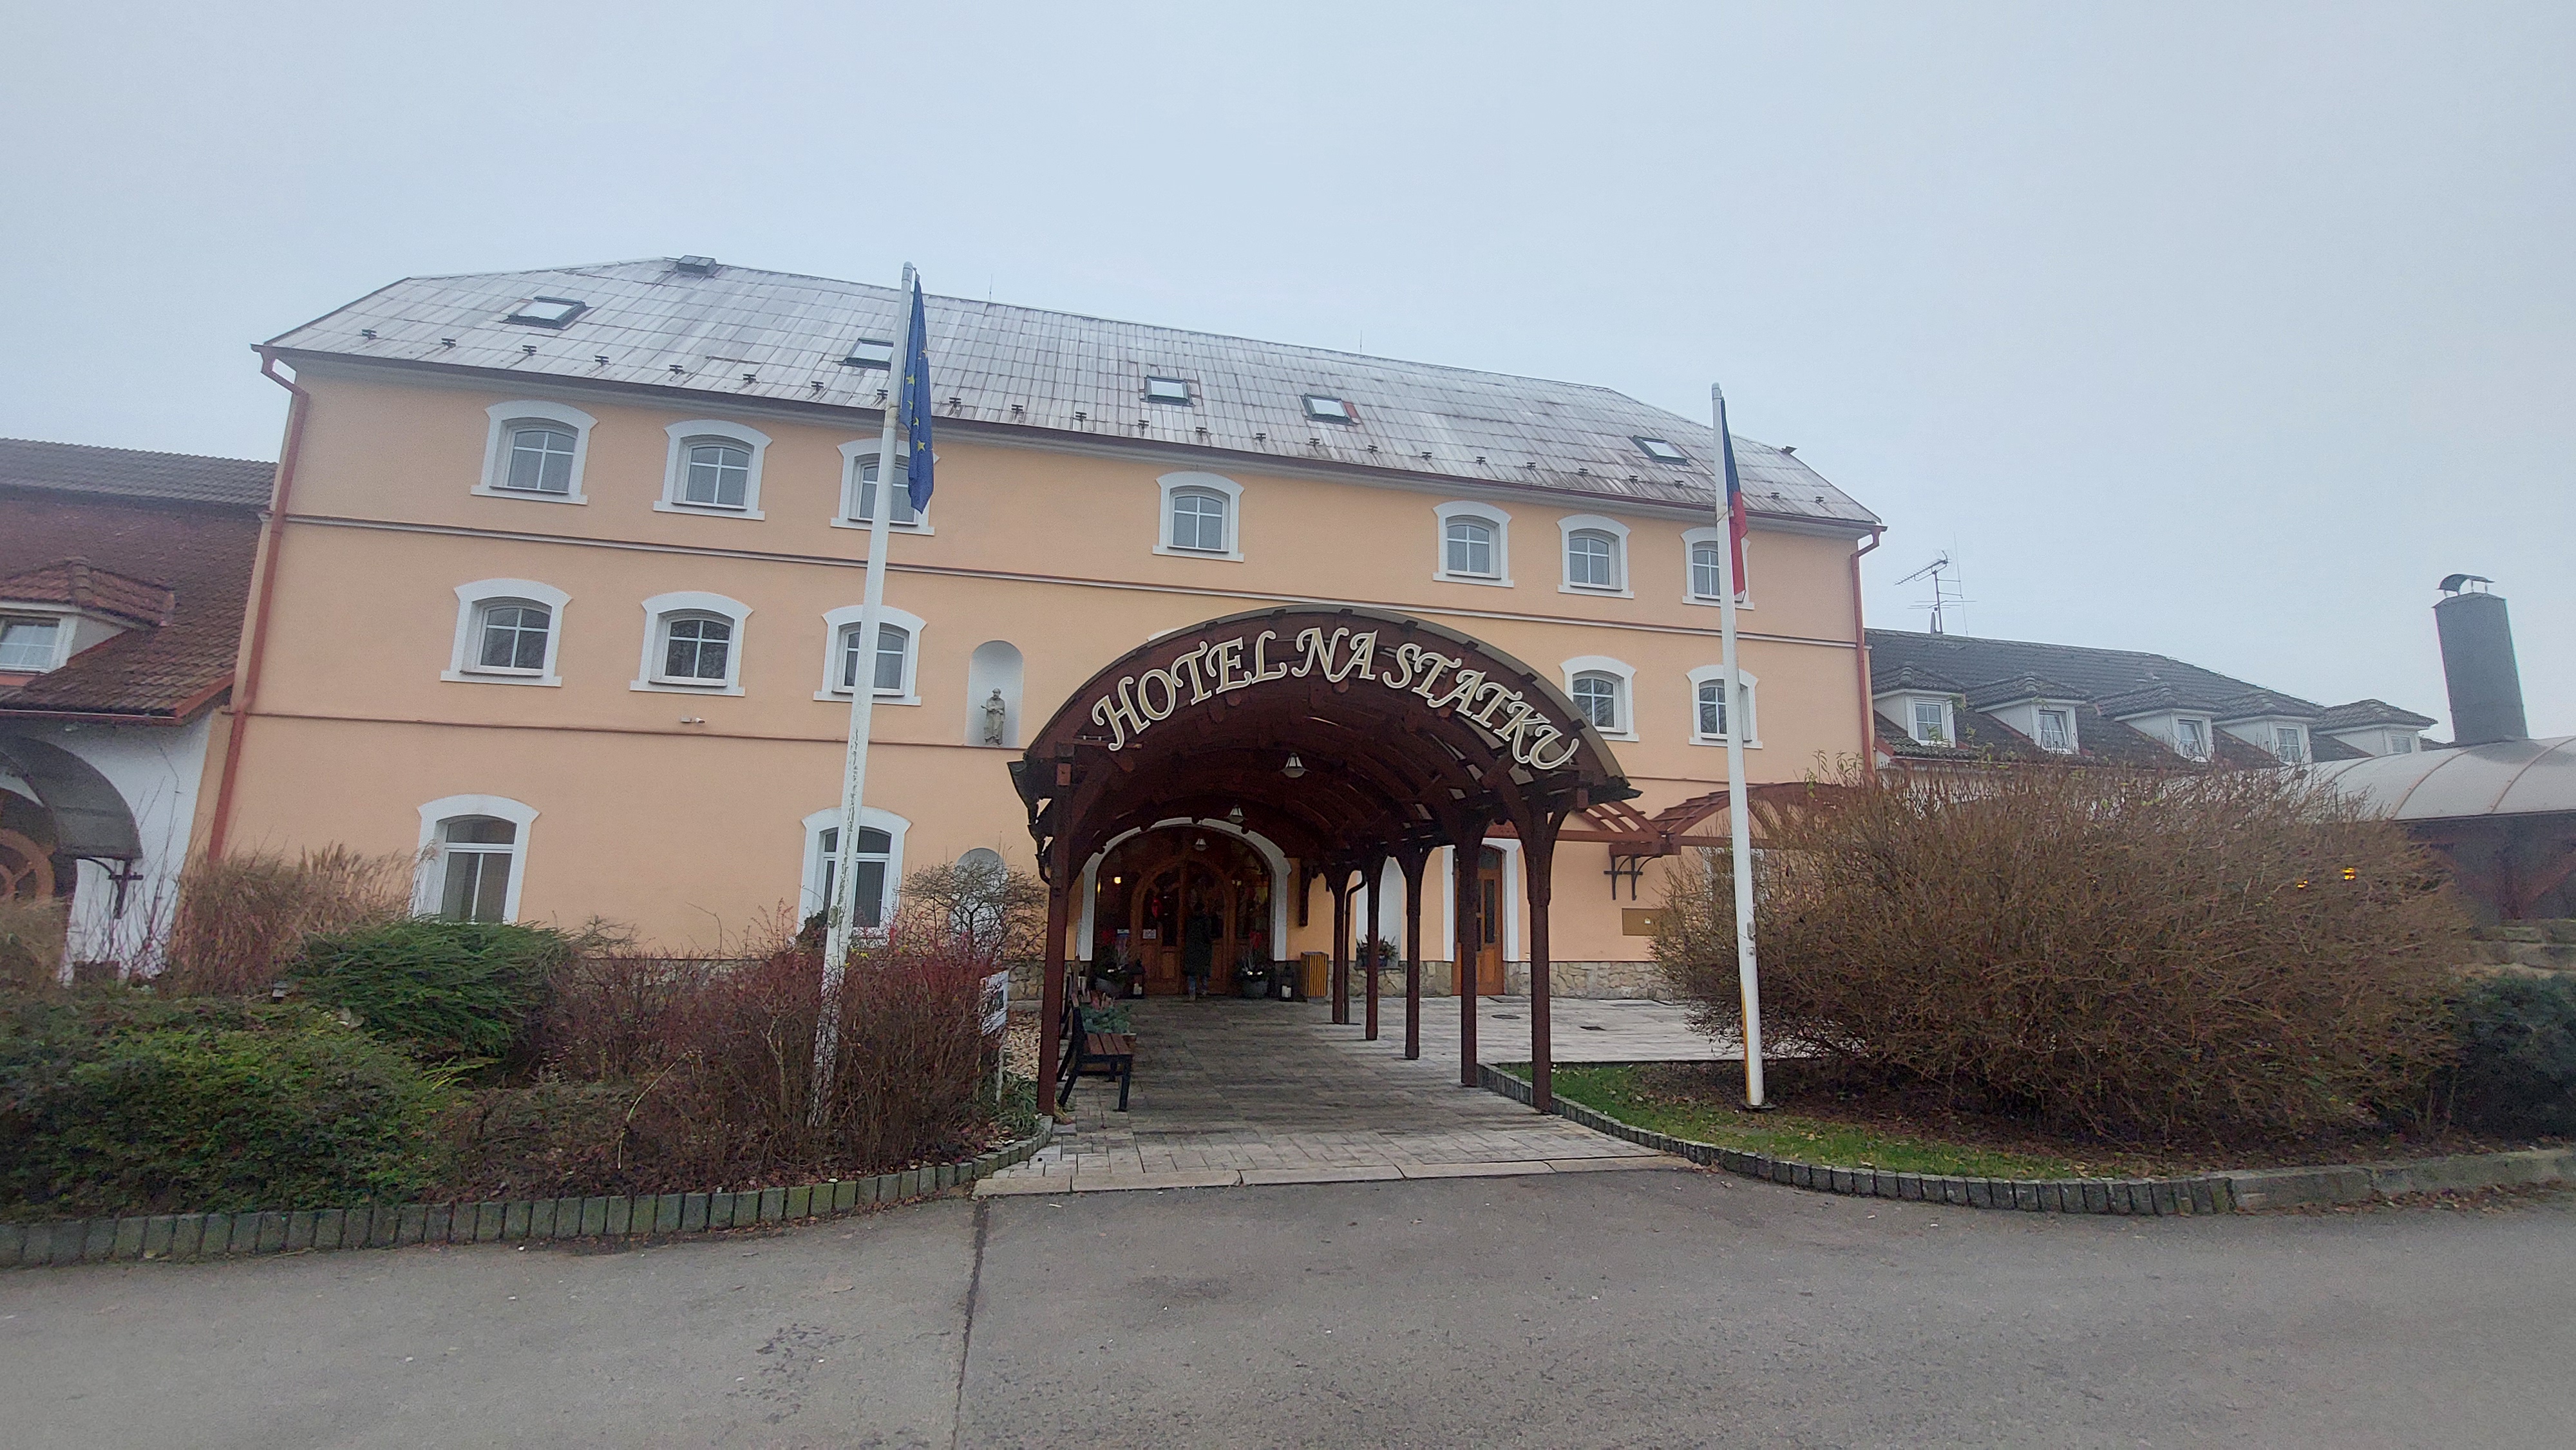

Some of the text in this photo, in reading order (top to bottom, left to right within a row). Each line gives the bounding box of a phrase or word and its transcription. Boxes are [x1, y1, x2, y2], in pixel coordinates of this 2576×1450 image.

[1092, 627, 1580, 769] HOTEL NA STATKU
